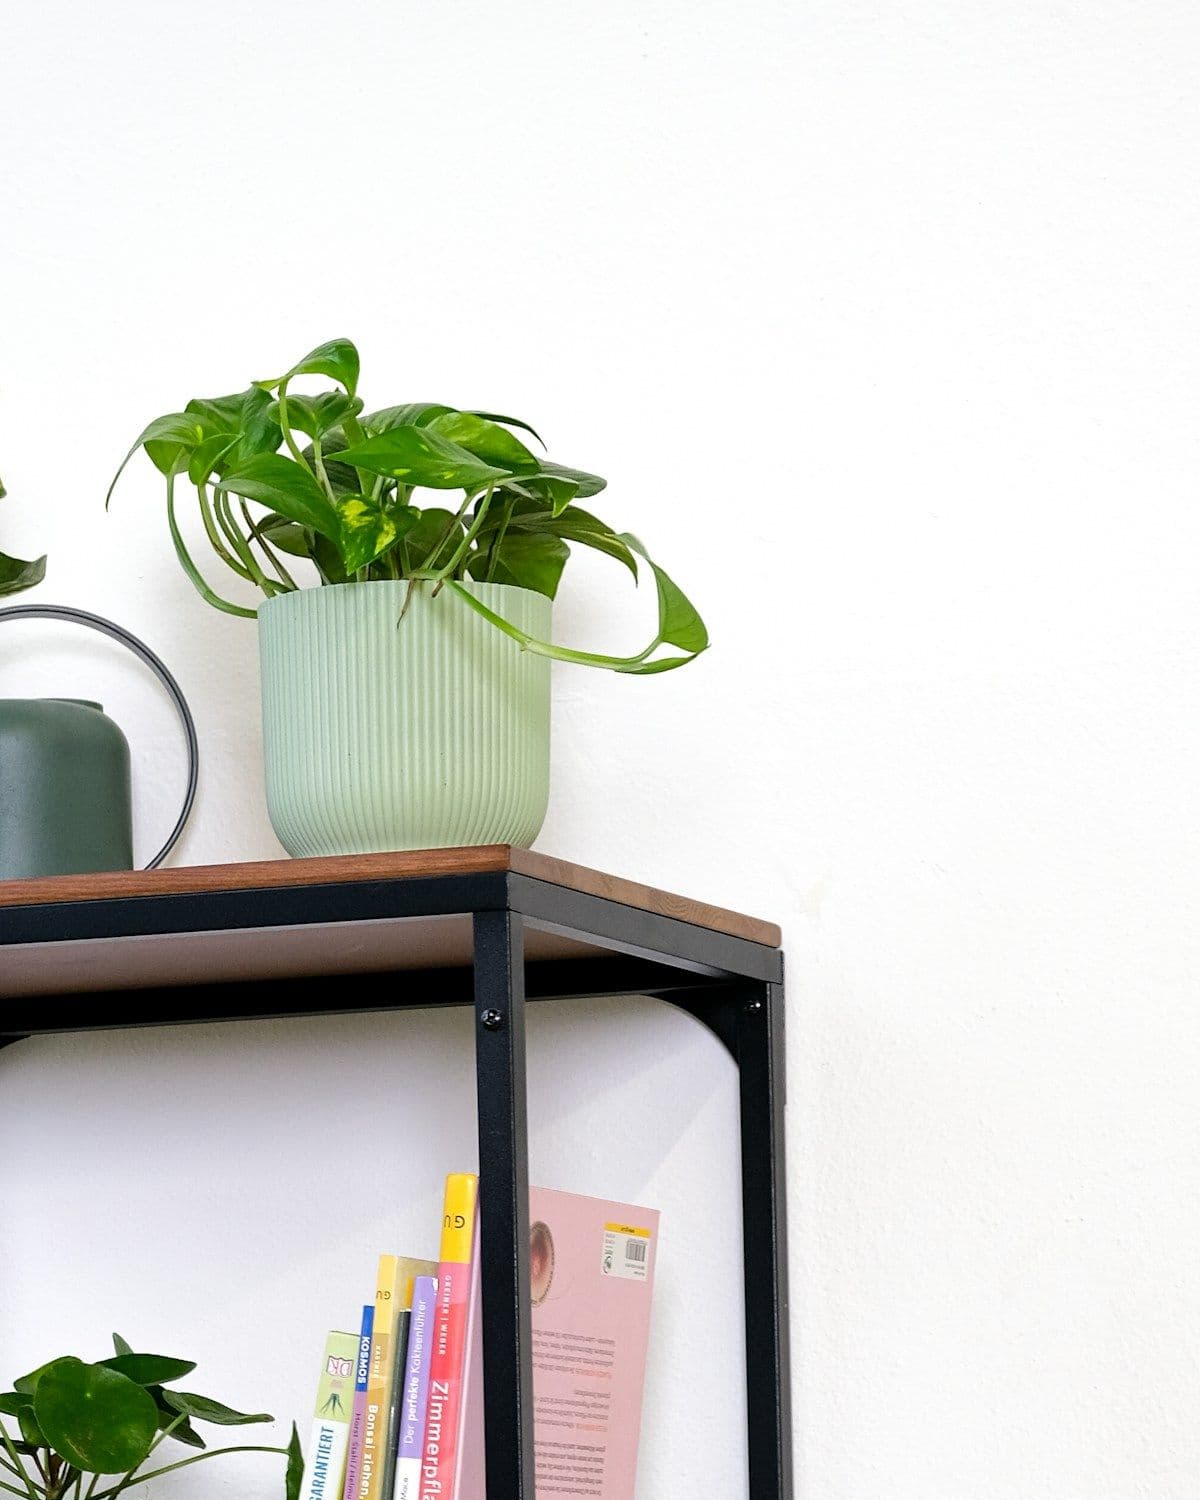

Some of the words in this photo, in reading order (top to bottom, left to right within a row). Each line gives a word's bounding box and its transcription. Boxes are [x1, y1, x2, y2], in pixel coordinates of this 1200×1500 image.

[357, 1336, 371, 1384] KOSMOS
[407, 1376, 420, 1422] perfekte
[353, 1413, 362, 1437] Horst
[365, 1404, 379, 1448] Bonsai
[404, 1426, 415, 1444] Der
[359, 1453, 374, 1500] ziehen,
